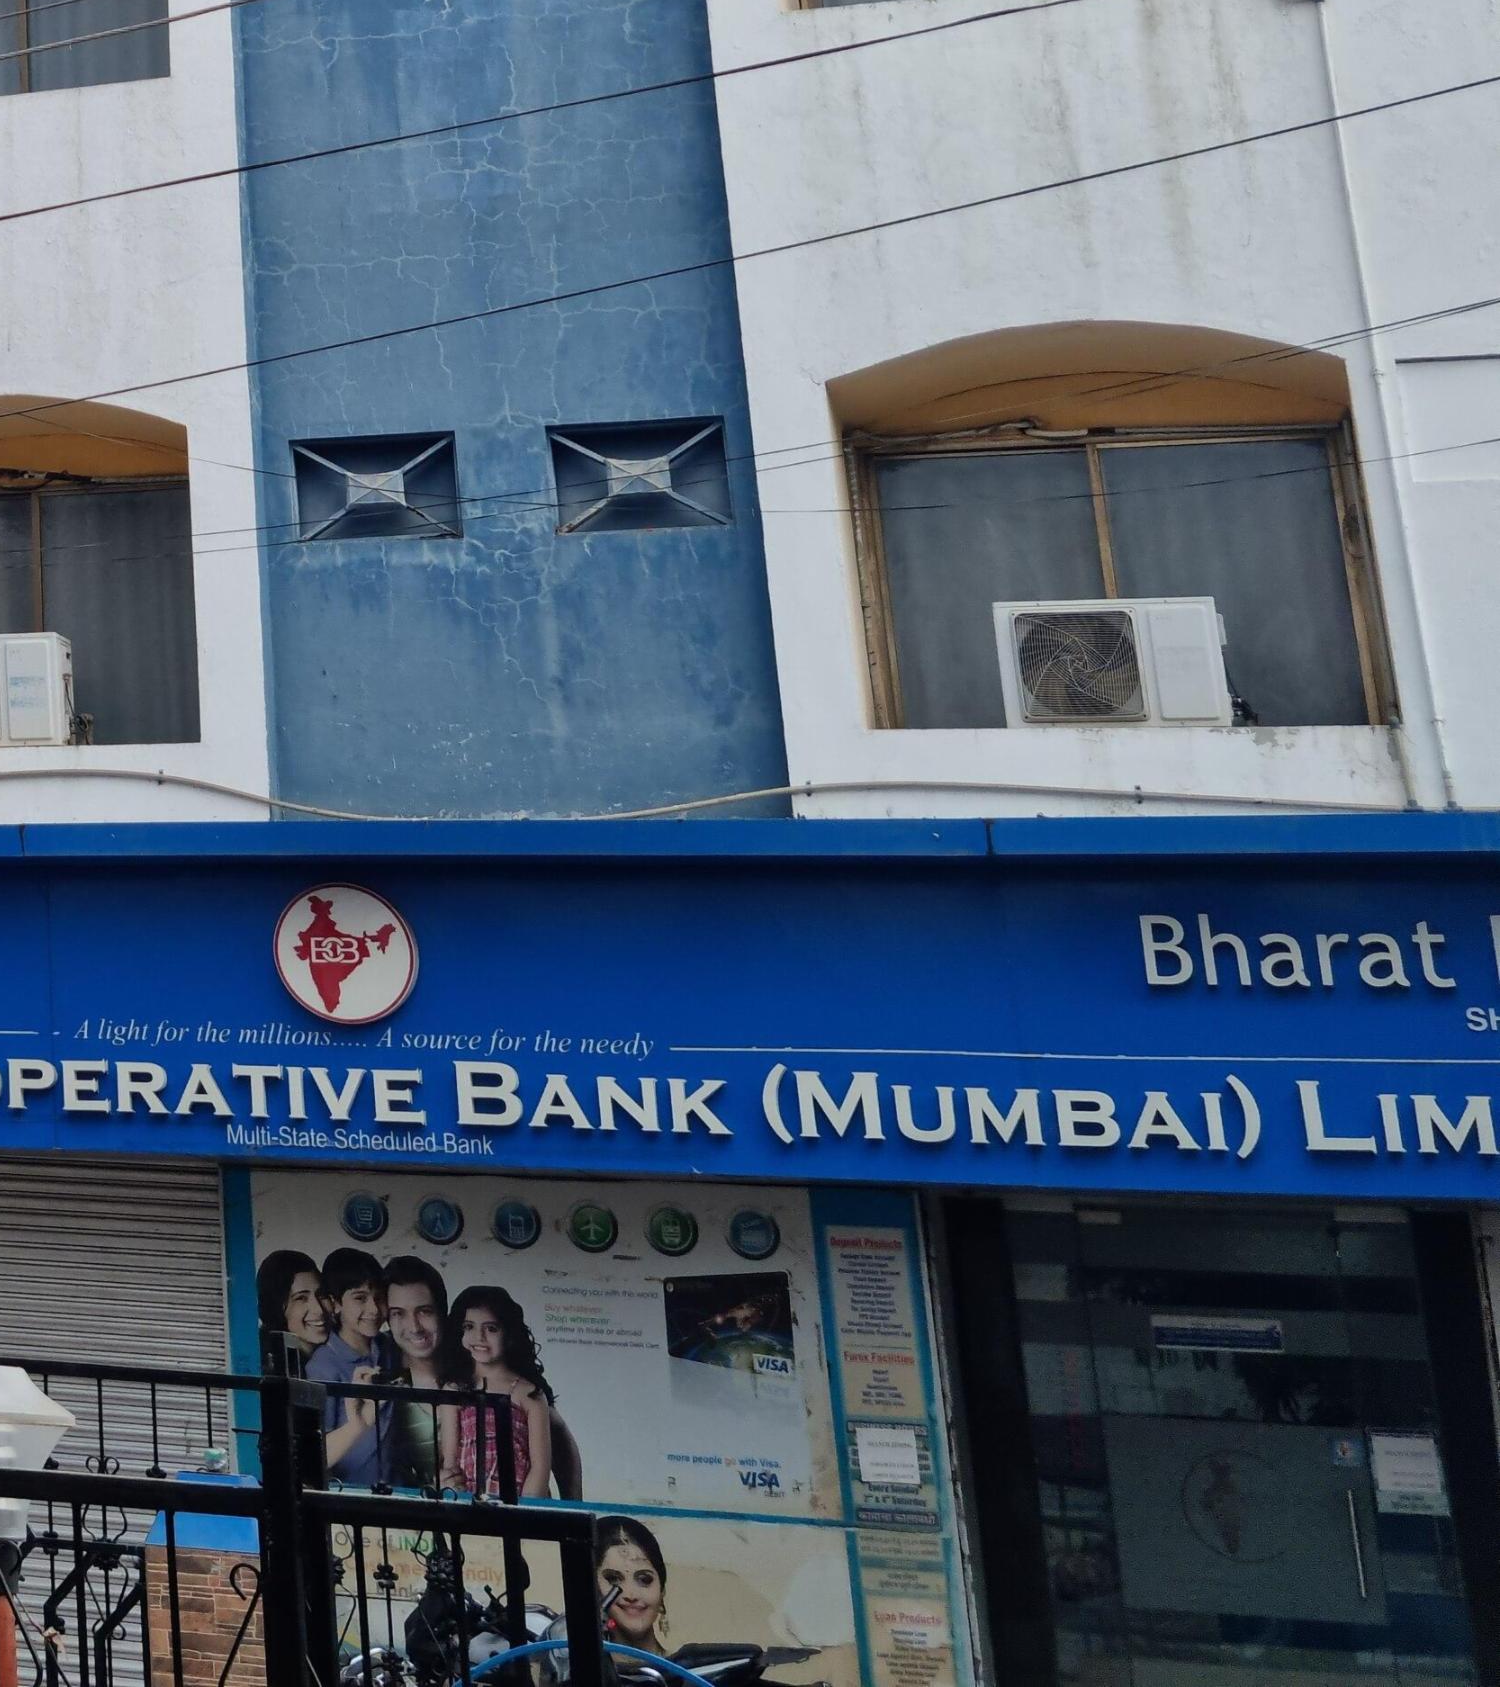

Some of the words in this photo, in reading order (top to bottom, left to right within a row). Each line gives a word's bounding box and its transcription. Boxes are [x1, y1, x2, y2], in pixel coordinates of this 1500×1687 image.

[1138, 913, 1457, 989] Bharat
[74, 1018, 90, 1040] A
[98, 1017, 150, 1046] light
[151, 1018, 190, 1047] for
[196, 1020, 232, 1044] the
[376, 1027, 393, 1049] A
[401, 1030, 482, 1051] source
[484, 1027, 527, 1057] for
[533, 1029, 573, 1054] the
[579, 1032, 654, 1062] needy
[452, 1060, 734, 1137] BANK
[761, 1062, 1262, 1160] (MUMBAI)
[226, 1123, 328, 1149] Multi-State
[334, 1127, 436, 1153] Scheduled
[443, 1131, 495, 1156] Bank
[757, 1357, 790, 1374] VISA
[739, 1470, 780, 1489] VISA
